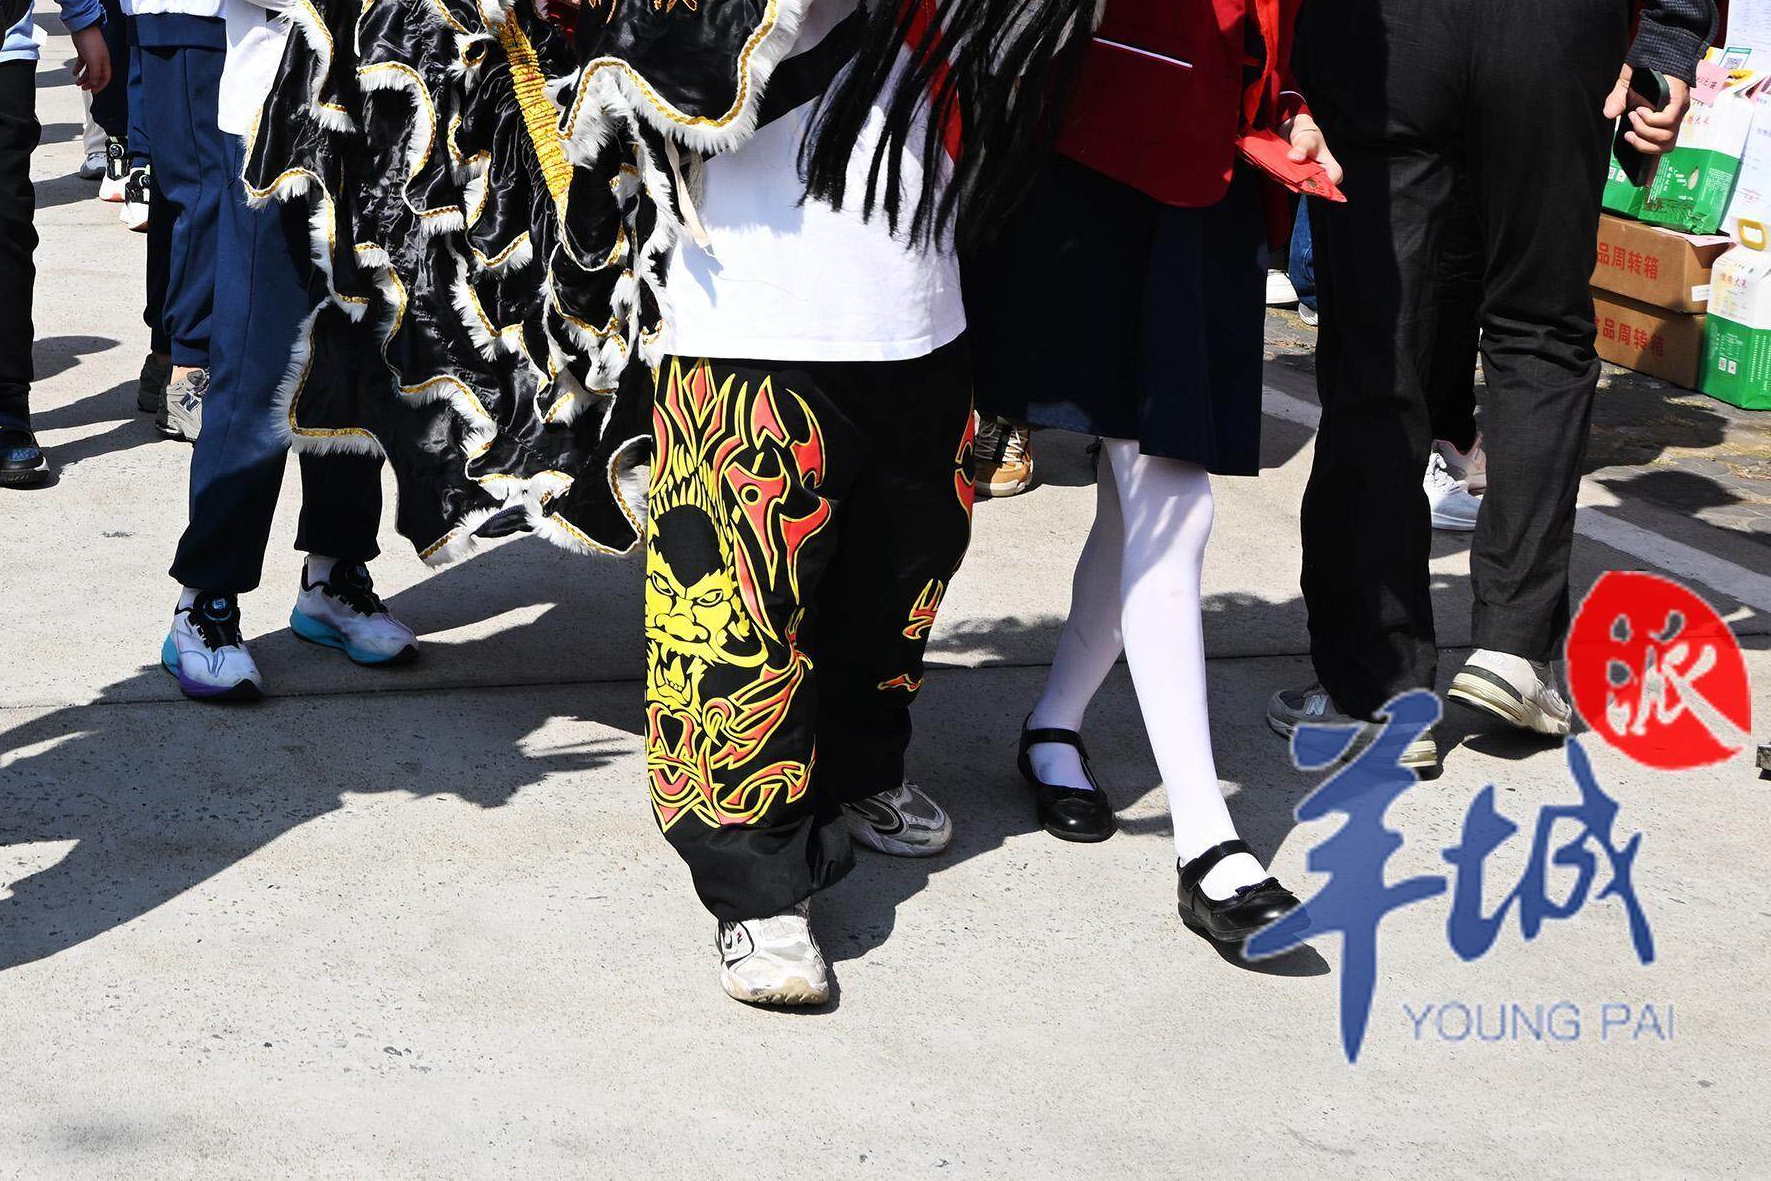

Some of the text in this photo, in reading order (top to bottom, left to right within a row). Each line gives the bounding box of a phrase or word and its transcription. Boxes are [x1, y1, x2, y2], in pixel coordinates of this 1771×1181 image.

[1597, 241, 1660, 281] 品周转箱
[1595, 316, 1665, 357] 品周转箱
